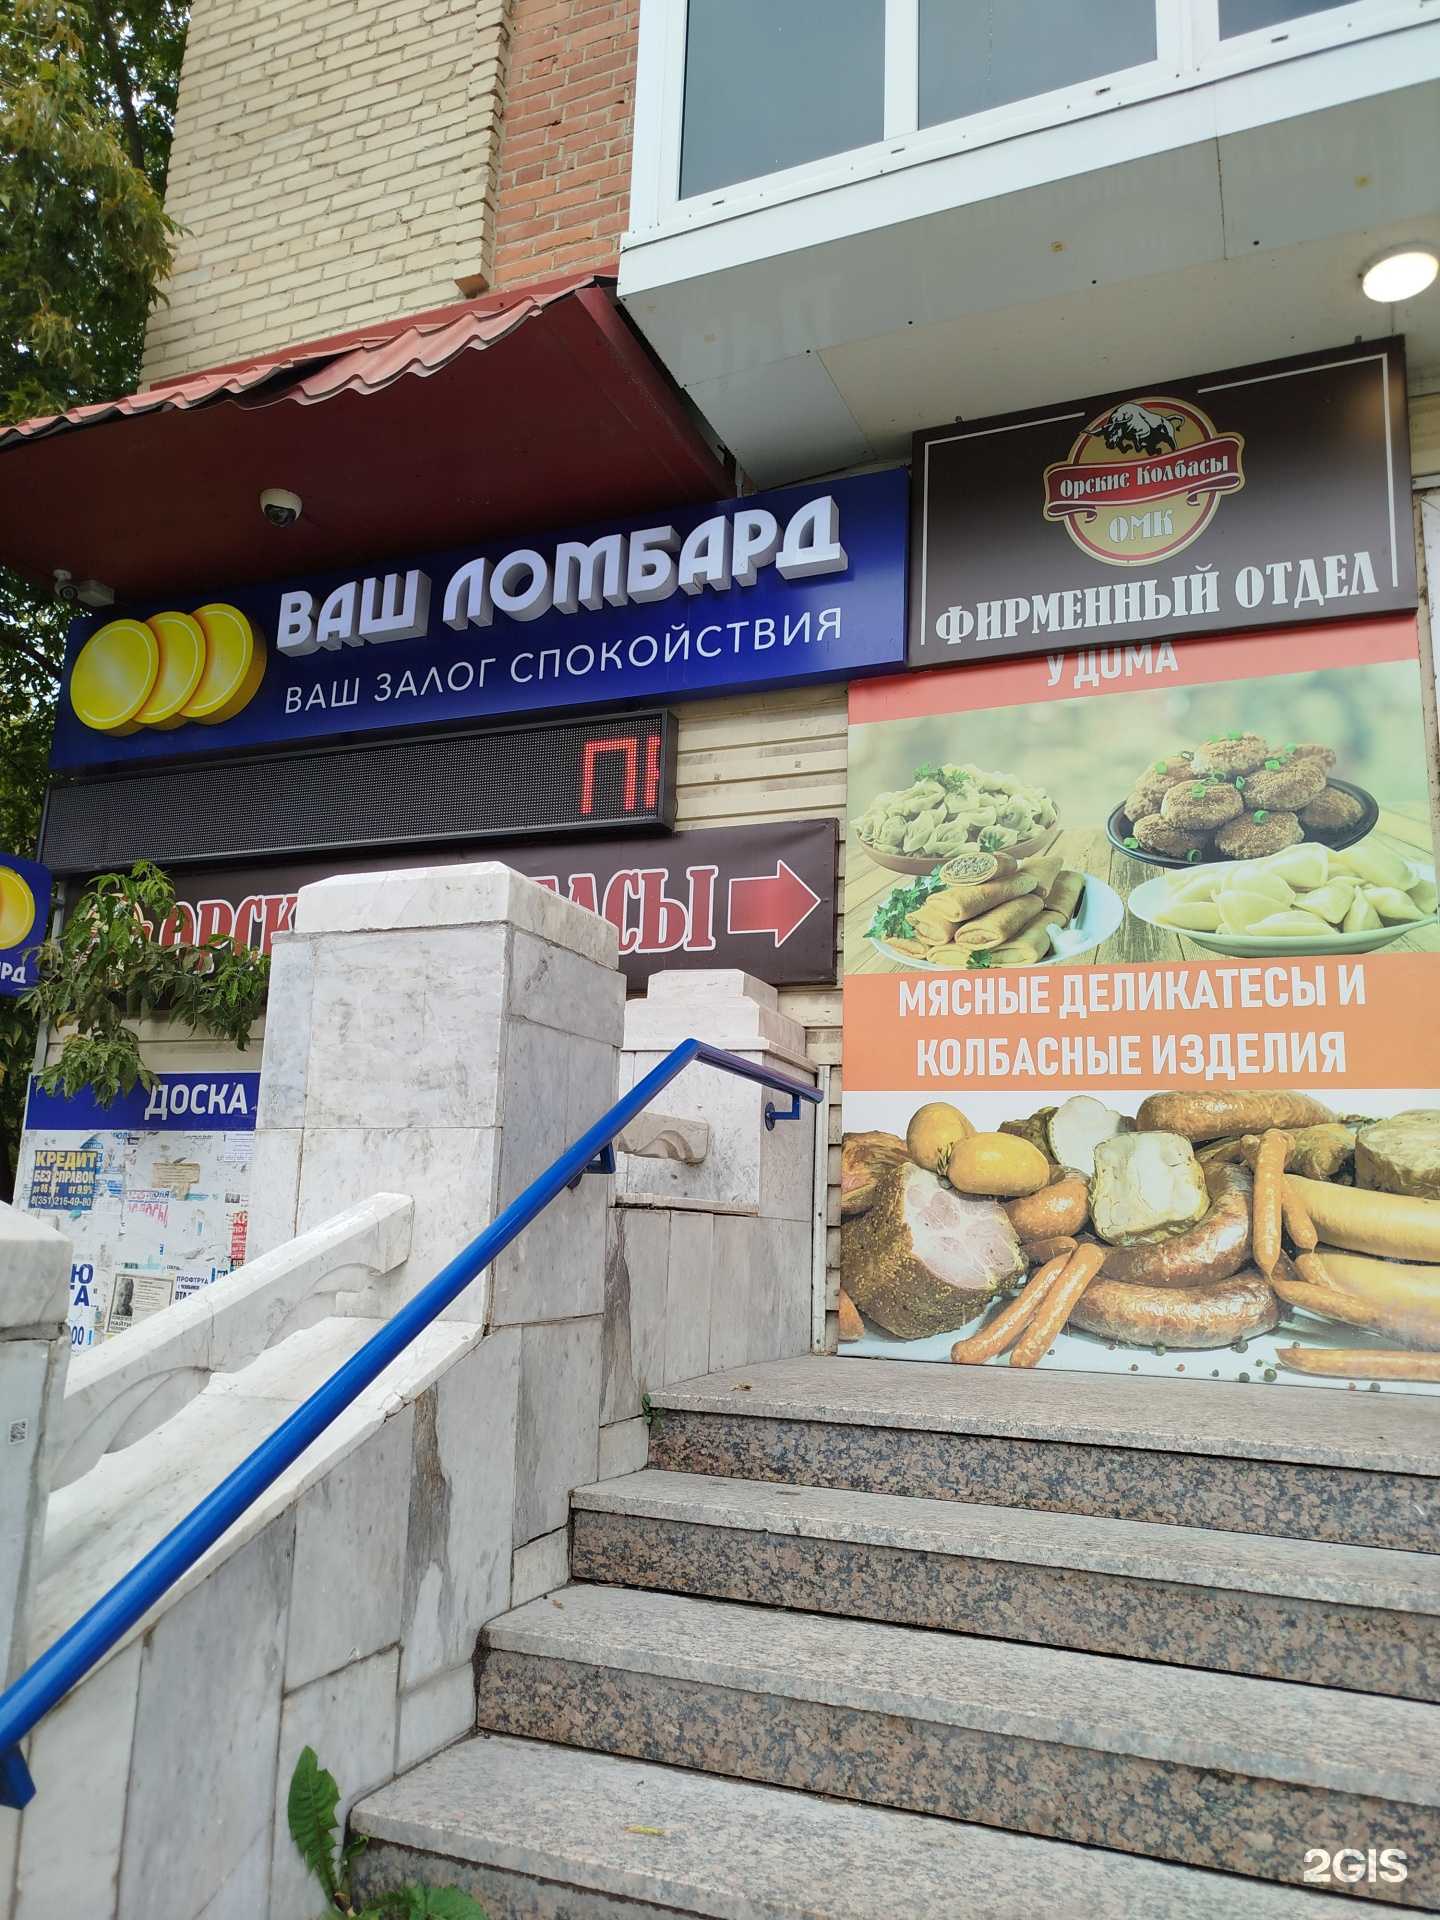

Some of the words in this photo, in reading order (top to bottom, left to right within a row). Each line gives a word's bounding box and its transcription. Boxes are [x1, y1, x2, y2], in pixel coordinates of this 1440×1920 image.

[1060, 470, 1131, 499] Орские
[1136, 454, 1229, 485] Колбасы
[1108, 509, 1174, 544] ОМК
[276, 569, 432, 658] ВАШ
[442, 495, 849, 631] ЛОМБАРД
[934, 562, 1220, 646] ФИРМЕННЫЙ
[1235, 550, 1380, 610] ОТДЕЛ
[284, 675, 360, 713] ВАШ
[373, 656, 497, 700] ЗАЛОГ
[510, 606, 844, 684] СПОКОЙСТВИЯ
[1073, 640, 1179, 689] ДОМА
[0, 961, 27, 984] РД
[899, 975, 1050, 1017] МЯСНЫЕ
[1059, 966, 1326, 1019] ДЕЛИКАТЕСЫ
[1338, 964, 1366, 1005] И
[917, 1036, 1142, 1076] КОЛБАСНЫЕ
[1152, 1031, 1347, 1081] ИЗДЕЛИЯ
[144, 1084, 248, 1121] ДОСКА
[35, 1151, 97, 1170] КРЕДИТ
